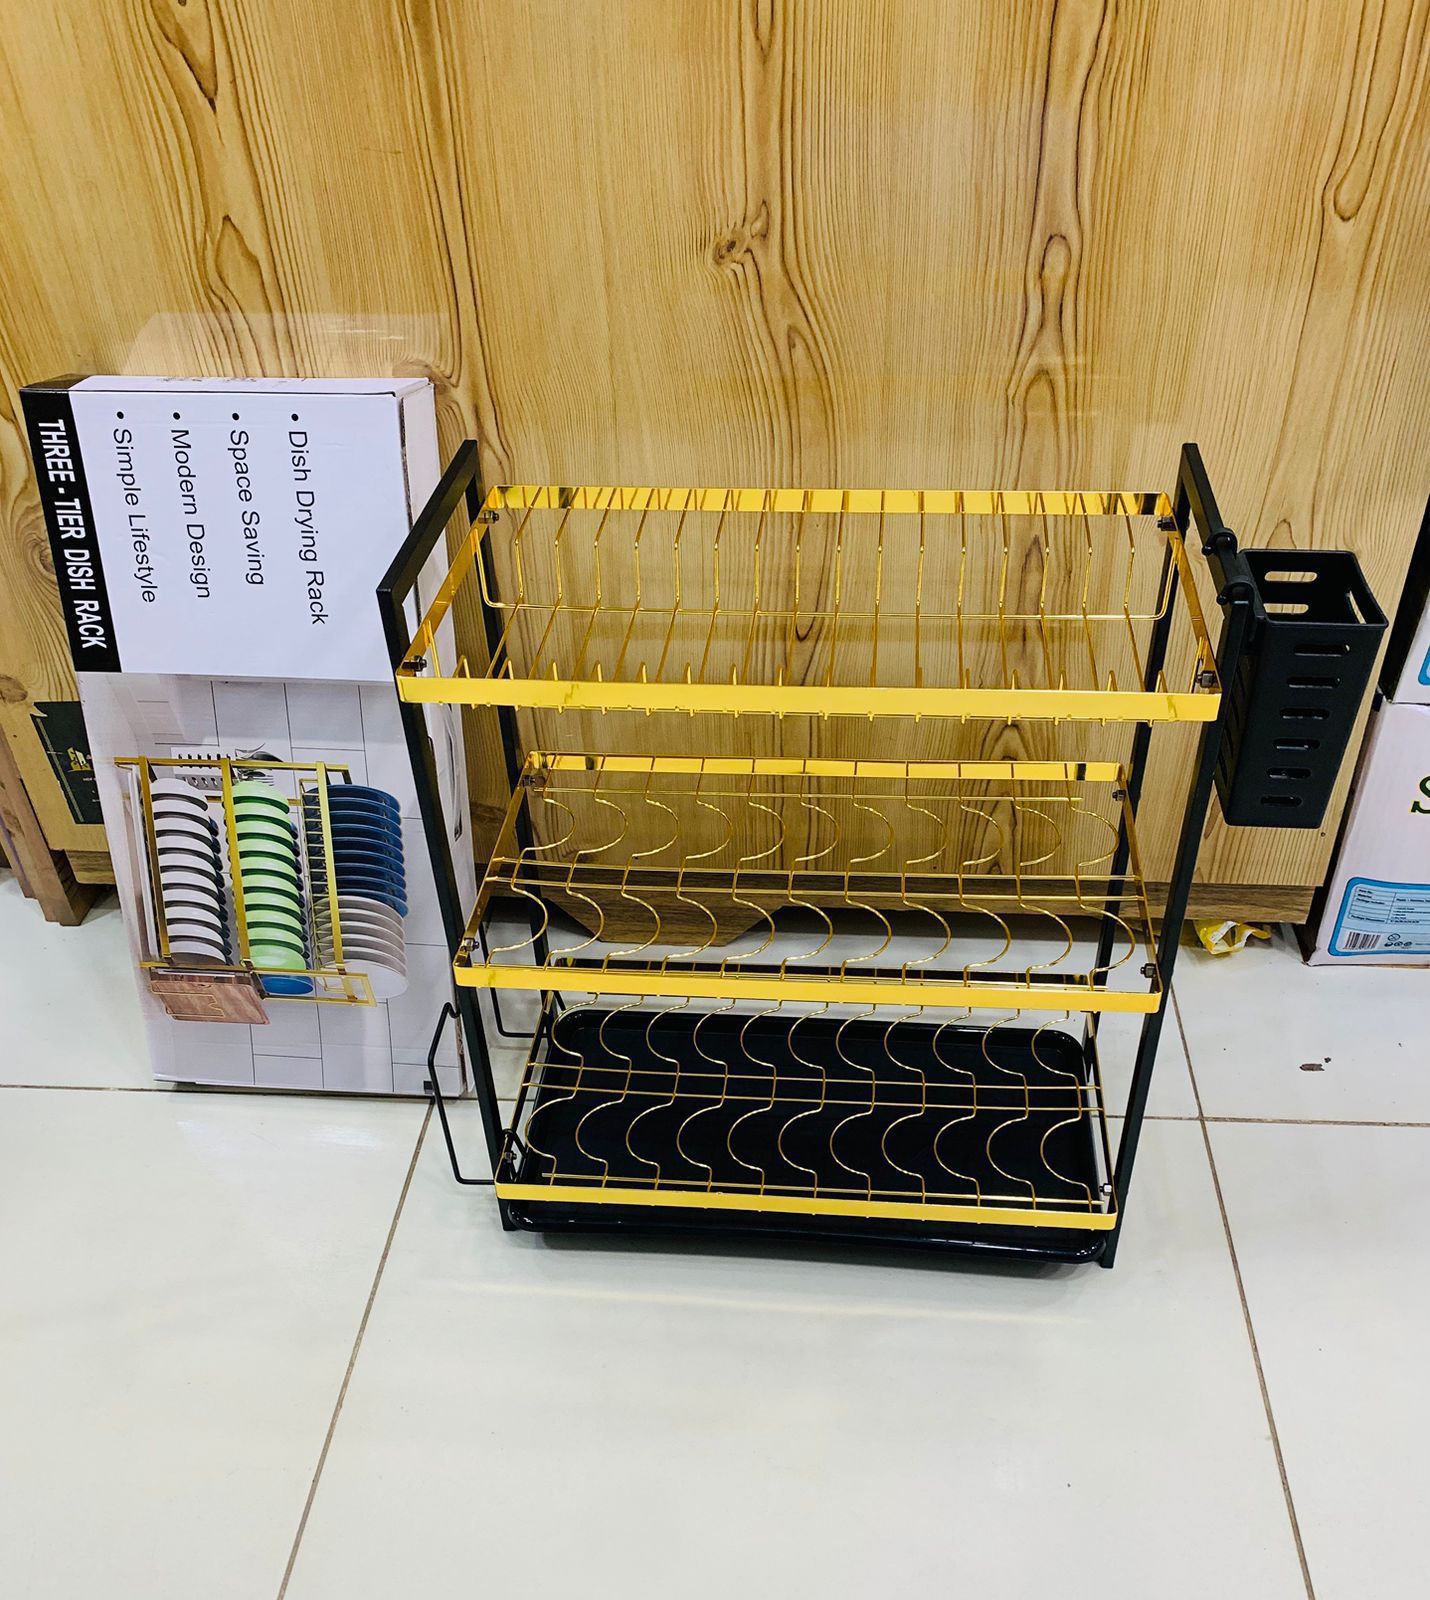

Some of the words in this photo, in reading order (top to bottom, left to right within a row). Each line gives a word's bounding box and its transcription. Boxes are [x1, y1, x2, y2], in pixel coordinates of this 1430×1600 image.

[288, 431, 312, 481] Dish
[55, 498, 86, 540] TIER
[113, 428, 141, 506] Simple
[129, 514, 158, 603] Lifestyle
[170, 429, 198, 515] Modern
[187, 524, 211, 599] Design
[228, 429, 253, 503] Space
[241, 510, 265, 586] Saving
[295, 490, 318, 562] Drying
[64, 549, 96, 590] DISH
[74, 600, 107, 649] RACK
[305, 570, 329, 625] Rack
